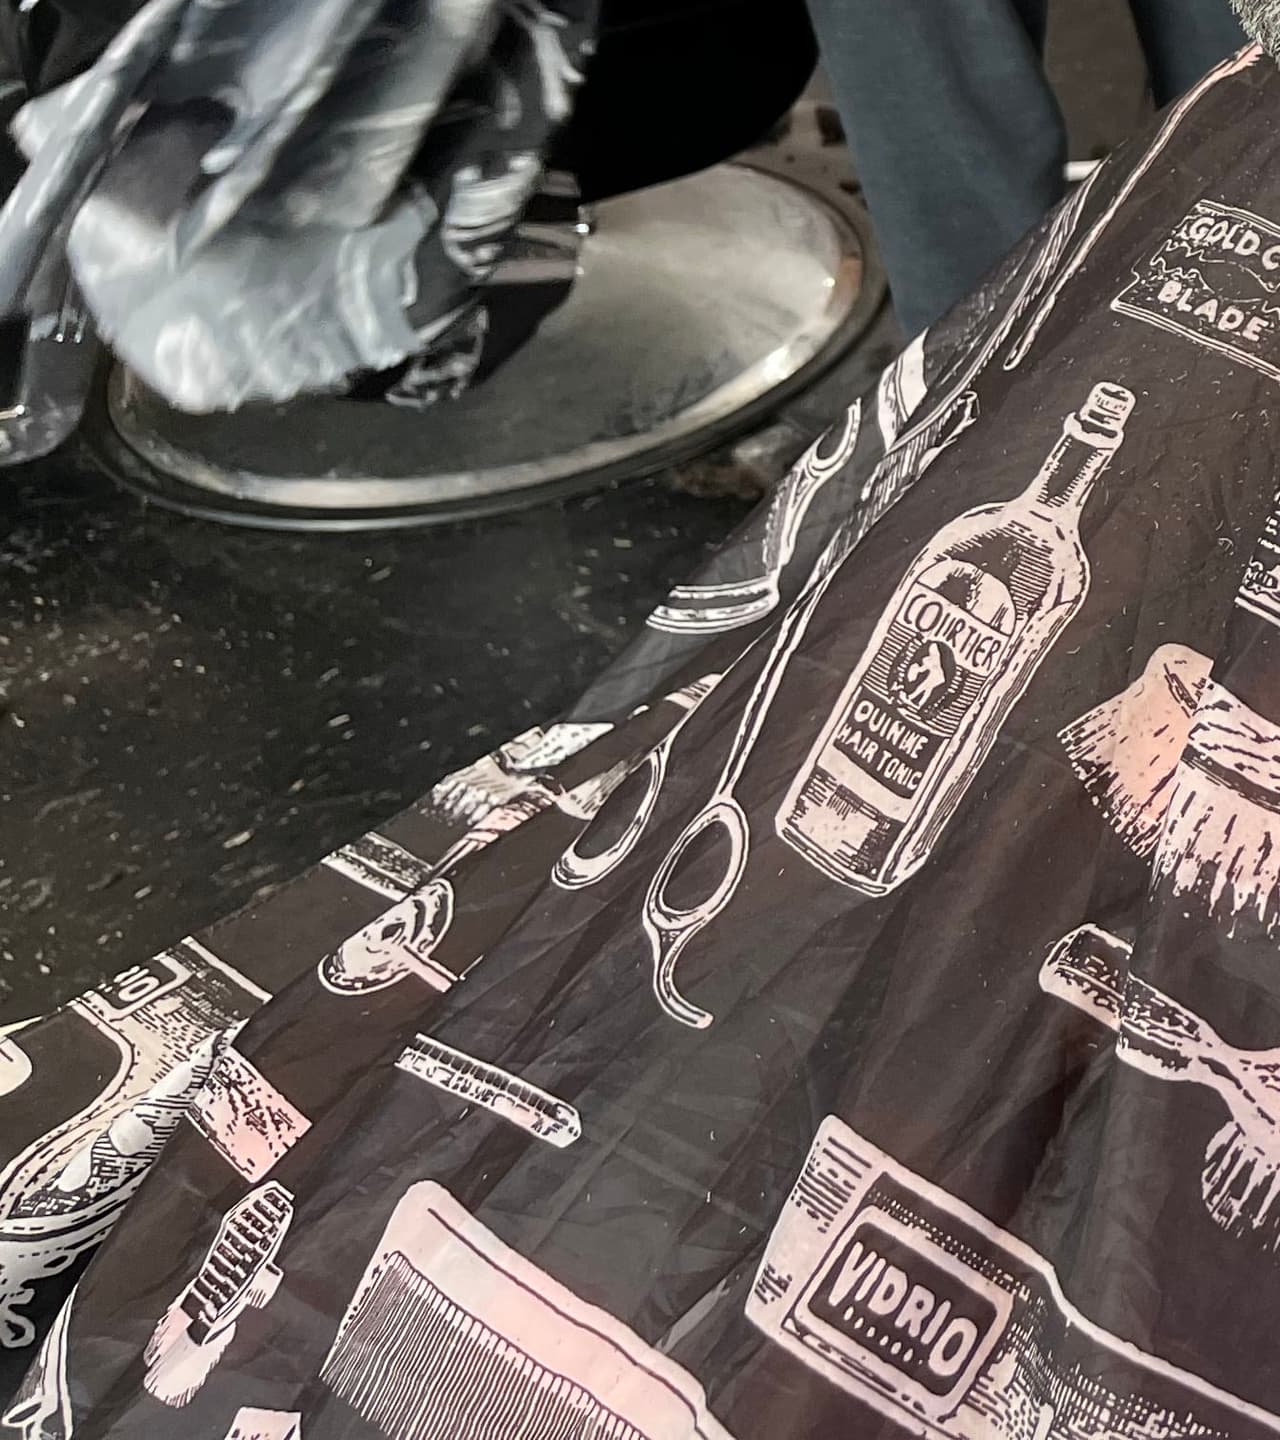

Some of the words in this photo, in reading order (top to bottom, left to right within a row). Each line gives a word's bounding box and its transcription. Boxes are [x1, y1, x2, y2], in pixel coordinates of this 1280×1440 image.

[1189, 216, 1262, 256] GOLD
[1157, 280, 1270, 342] BLADE
[836, 722, 880, 764] HAIR
[876, 749, 923, 791] TONIC
[823, 1240, 979, 1377] VIDRIO
